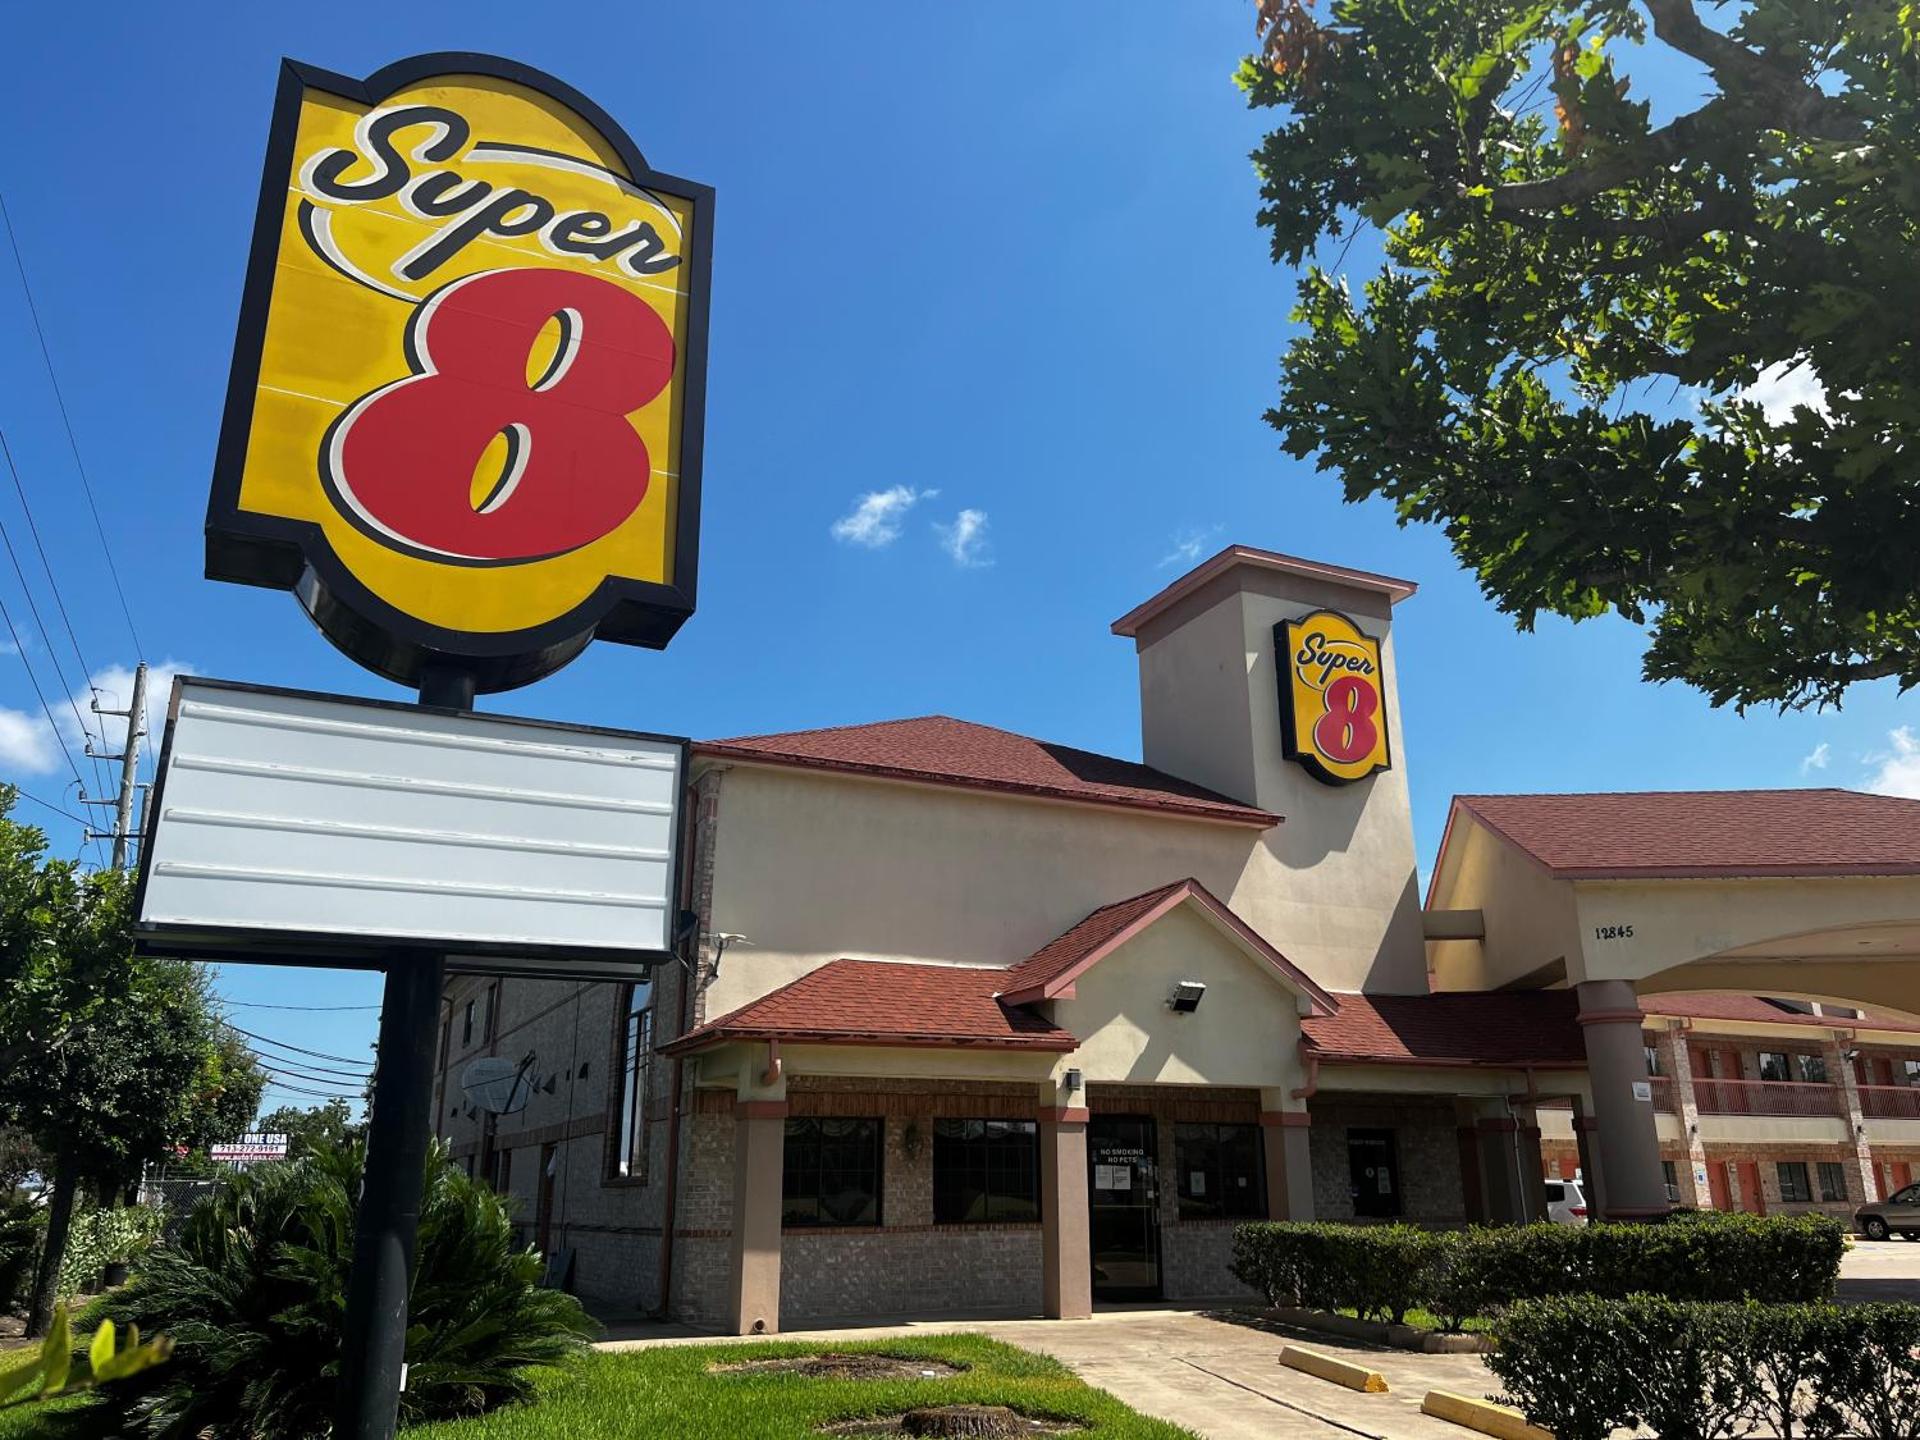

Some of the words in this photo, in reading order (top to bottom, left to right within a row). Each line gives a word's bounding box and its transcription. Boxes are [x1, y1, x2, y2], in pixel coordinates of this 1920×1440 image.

[299, 104, 684, 282] Super
[317, 267, 676, 568] 8
[1297, 632, 1375, 687] Super
[1313, 675, 1378, 765] 8
[1595, 925, 1634, 940] 12845
[244, 1133, 265, 1144] ONE
[266, 1133, 287, 1144] USA
[1100, 1148, 1111, 1156] NO
[1112, 1148, 1144, 1156] SMOKING
